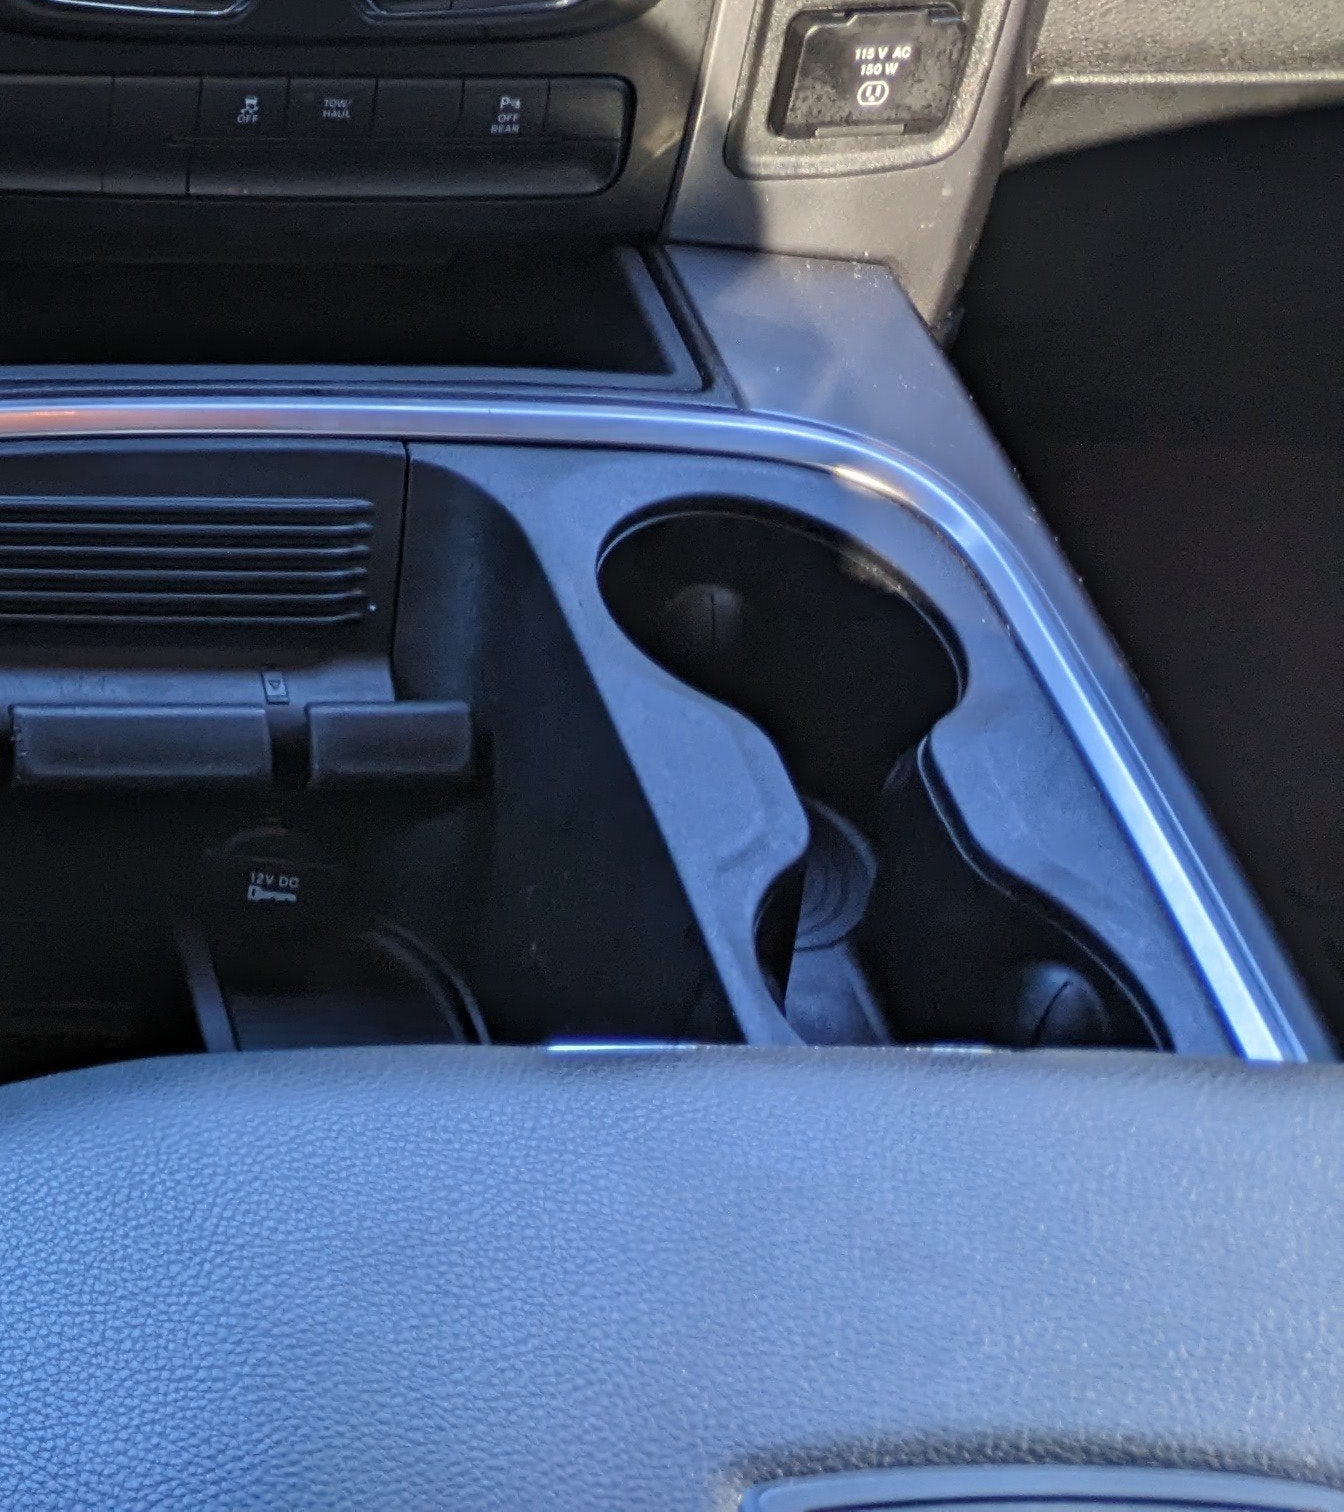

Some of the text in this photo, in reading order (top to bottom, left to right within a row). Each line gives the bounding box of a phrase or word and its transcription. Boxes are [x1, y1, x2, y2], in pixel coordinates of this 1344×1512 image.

[877, 47, 889, 60] V
[892, 46, 912, 60] AC
[884, 63, 900, 75] W
[236, 113, 260, 125] OFF
[322, 109, 352, 120] HAUL
[497, 113, 520, 124] OFF
[249, 871, 301, 889] 12V DC
